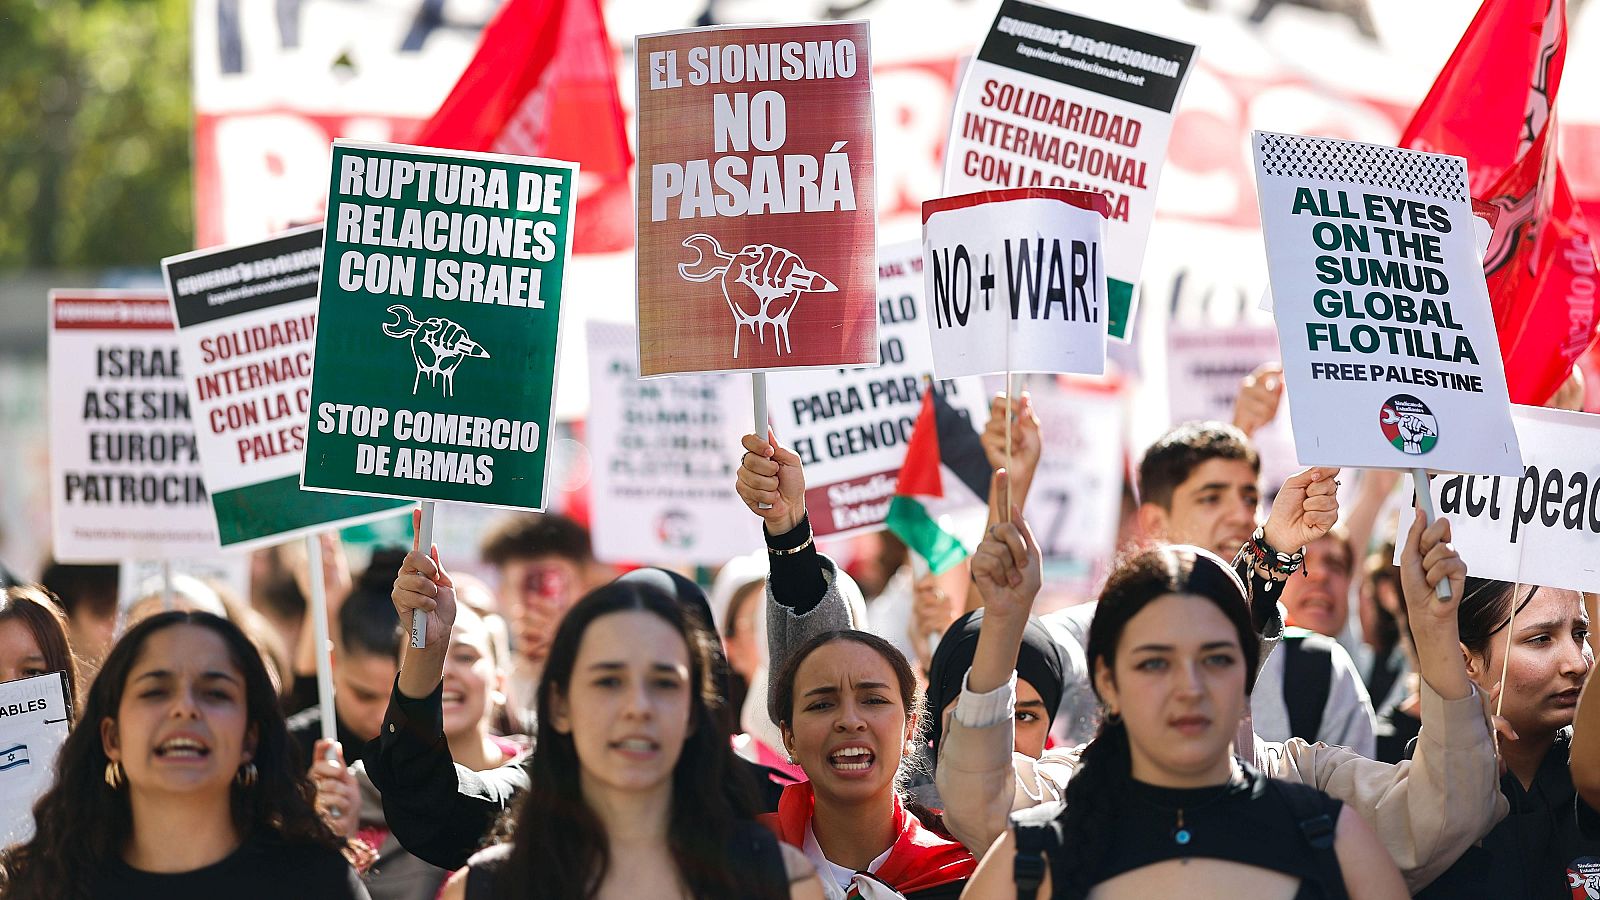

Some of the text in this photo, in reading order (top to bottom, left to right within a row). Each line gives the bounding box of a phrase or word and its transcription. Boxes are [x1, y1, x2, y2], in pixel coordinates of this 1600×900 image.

[650, 39, 857, 90] EL SIONISMO
[714, 90, 786, 152] NO
[981, 79, 1142, 148] SOLIDARIDAD
[962, 112, 1148, 190] INTERNACIONAL
[963, 150, 1012, 187] CON
[339, 155, 509, 210] RUPTURA
[517, 171, 563, 215] DE
[652, 141, 857, 222] PASARÁ
[336, 203, 556, 262] RELACIONES
[1292, 187, 1451, 234] ALL EYES
[1312, 222, 1444, 264] ON THE
[339, 251, 545, 309] CON ISRAEL
[1004, 238, 1098, 323] WAR!
[1315, 255, 1449, 296] SUMUD
[1313, 290, 1464, 331] GLOBAL
[1306, 322, 1480, 365] FLOTILLA
[197, 353, 311, 401] INTERNAC
[1311, 362, 1483, 393] FREE PALESTINE
[84, 391, 191, 420] ASESIN
[210, 401, 258, 434] CON
[264, 393, 291, 421] LA
[317, 403, 540, 452] STOP COMERCIO
[793, 387, 864, 425] PARA
[238, 425, 305, 464] PALES
[356, 444, 494, 486] DE ARMAS
[0, 698, 47, 718] ABLES
